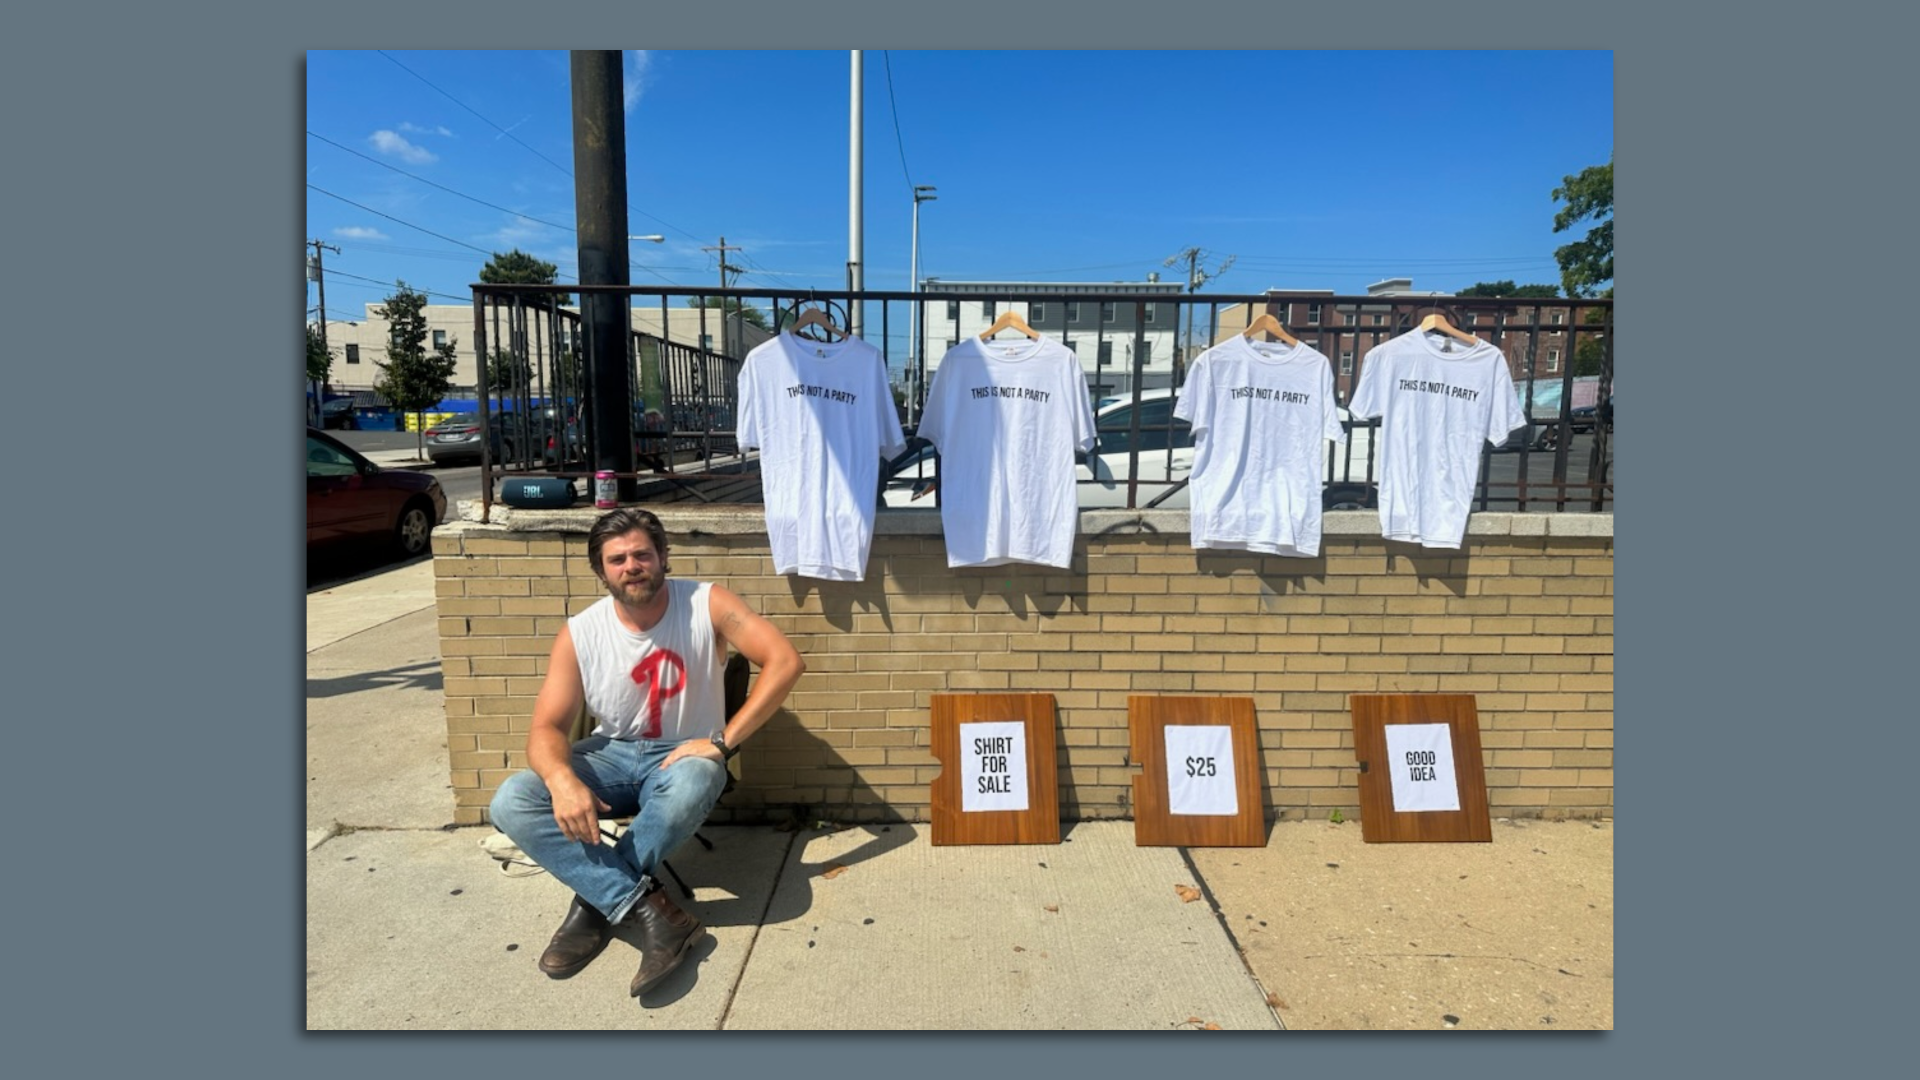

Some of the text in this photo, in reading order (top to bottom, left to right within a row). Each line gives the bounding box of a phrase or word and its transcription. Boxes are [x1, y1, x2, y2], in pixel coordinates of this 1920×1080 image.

[807, 385, 823, 397] NOT
[824, 388, 830, 400] A
[831, 389, 857, 405] PARTY
[971, 386, 1051, 404] THIS IS NOT A PARTY
[1255, 388, 1273, 400] NOT
[1273, 390, 1280, 402] A
[1281, 391, 1310, 405] PARTY
[1399, 379, 1479, 402] THIS IS NOT A PARTY
[523, 485, 544, 498] JBL
[631, 648, 687, 739] P
[974, 736, 1013, 755] SHIRT
[982, 755, 1007, 773] FOR
[1185, 755, 1217, 778] $25
[1405, 750, 1436, 766] GOOD
[1409, 766, 1437, 782] IDEA
[977, 774, 1011, 794] SALE
